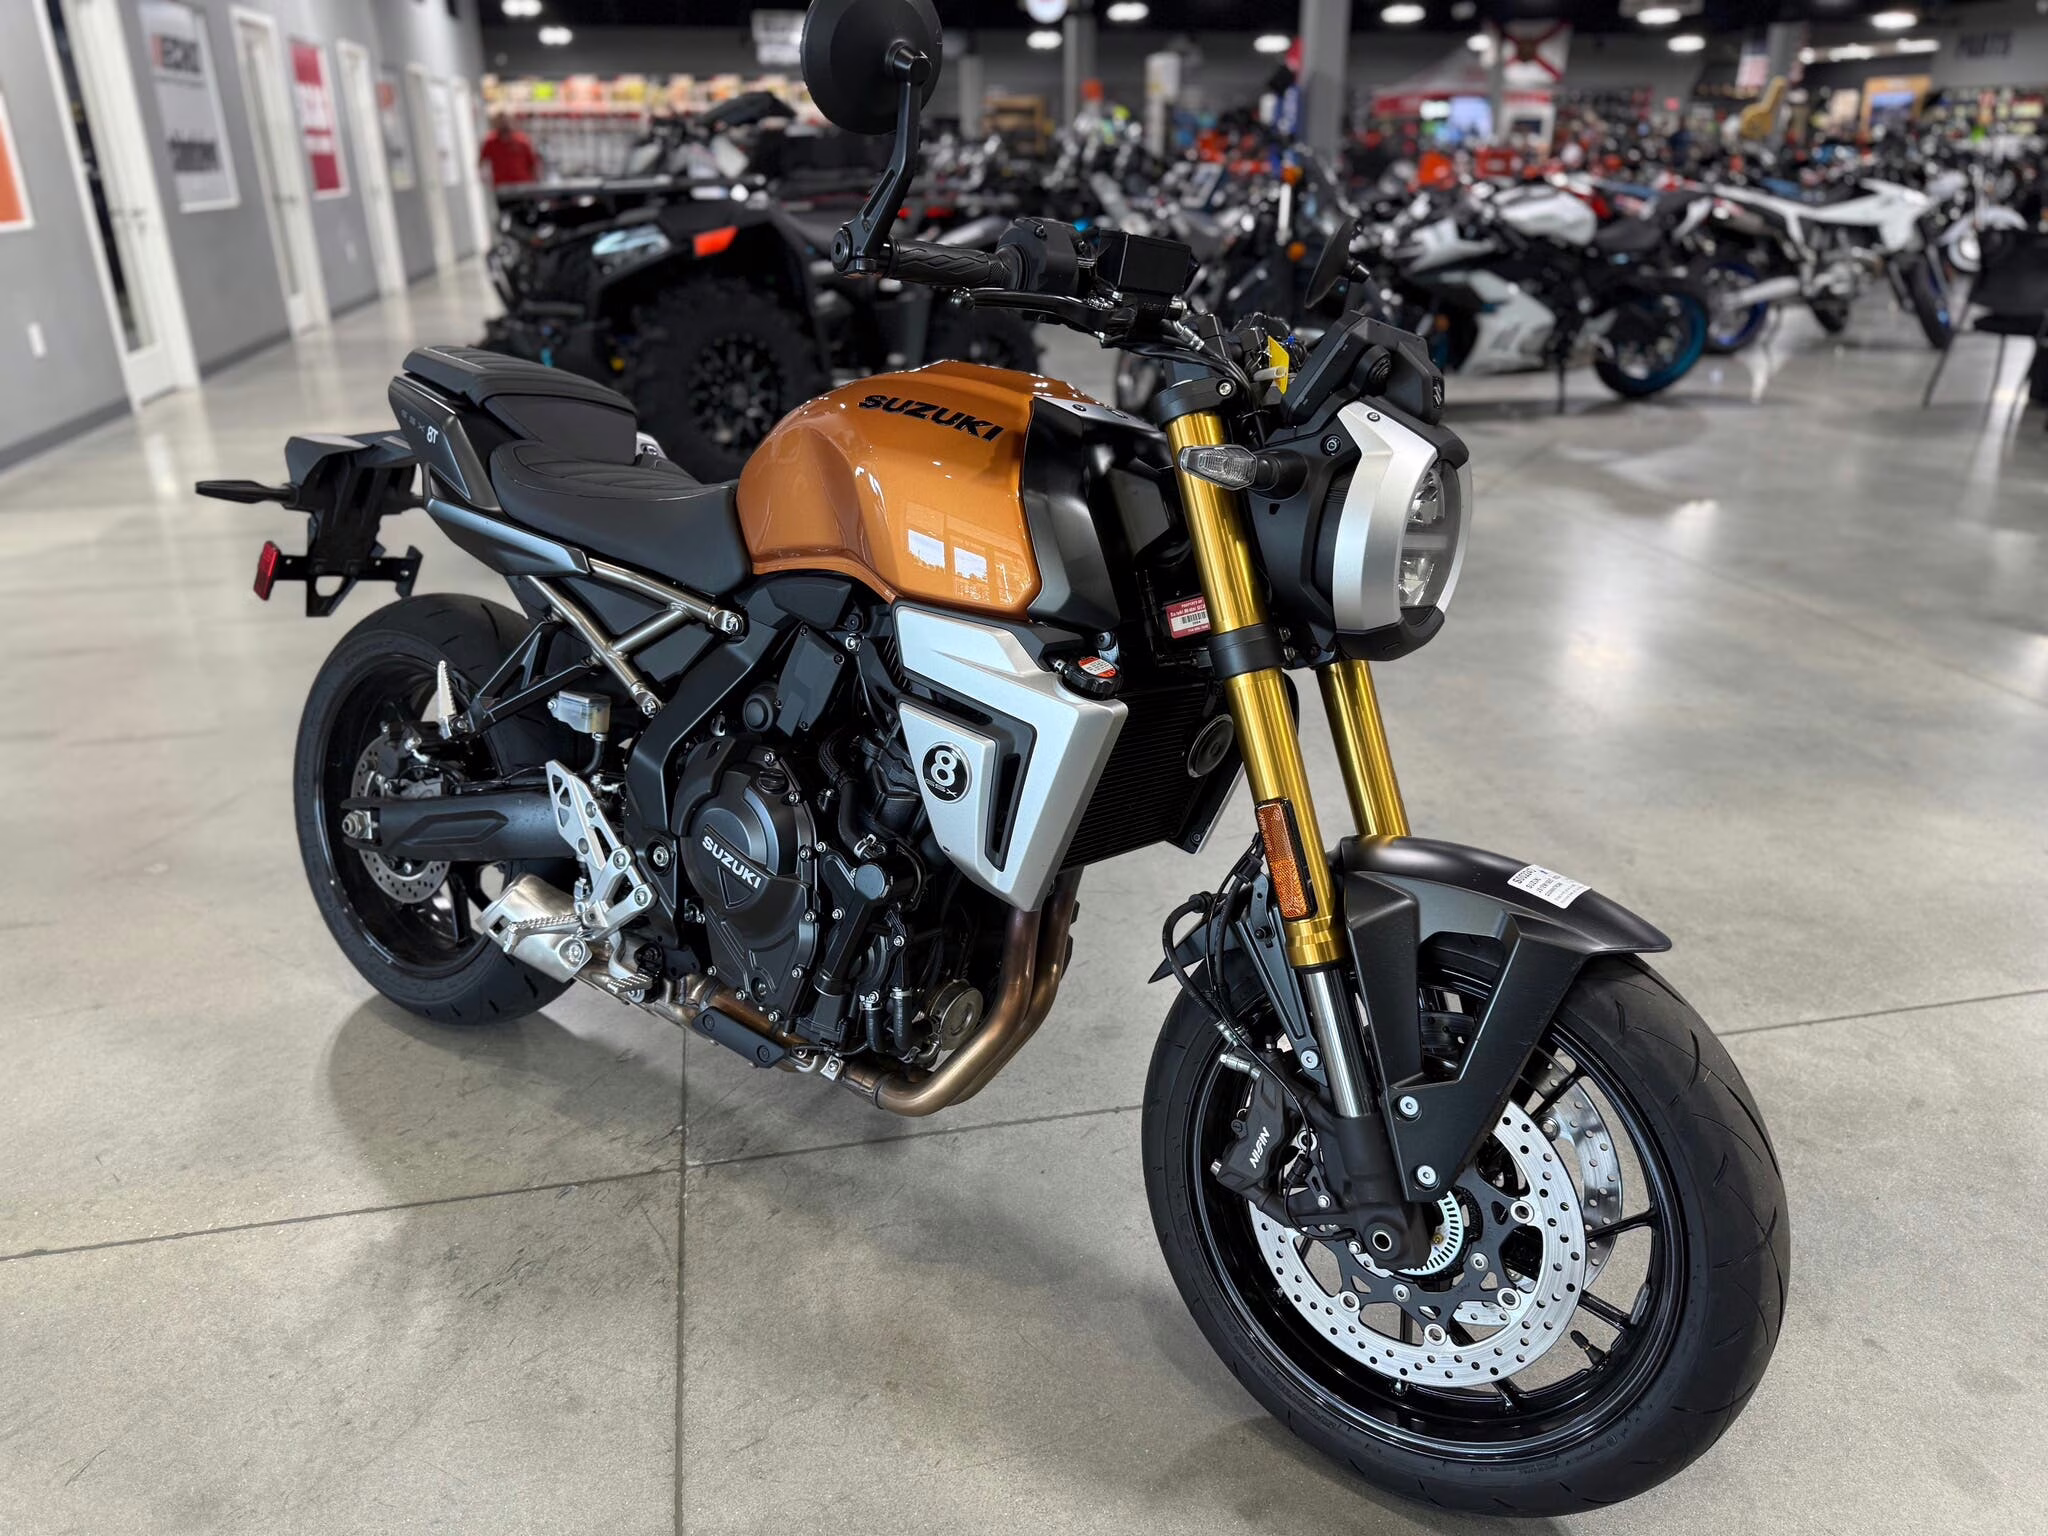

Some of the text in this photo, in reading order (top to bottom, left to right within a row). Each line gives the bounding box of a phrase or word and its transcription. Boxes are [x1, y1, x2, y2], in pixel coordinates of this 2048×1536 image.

[427, 425, 439, 444] 8T
[858, 395, 1004, 442] SUZUKI
[931, 750, 957, 787] 8
[702, 835, 761, 889] SUZUKI
